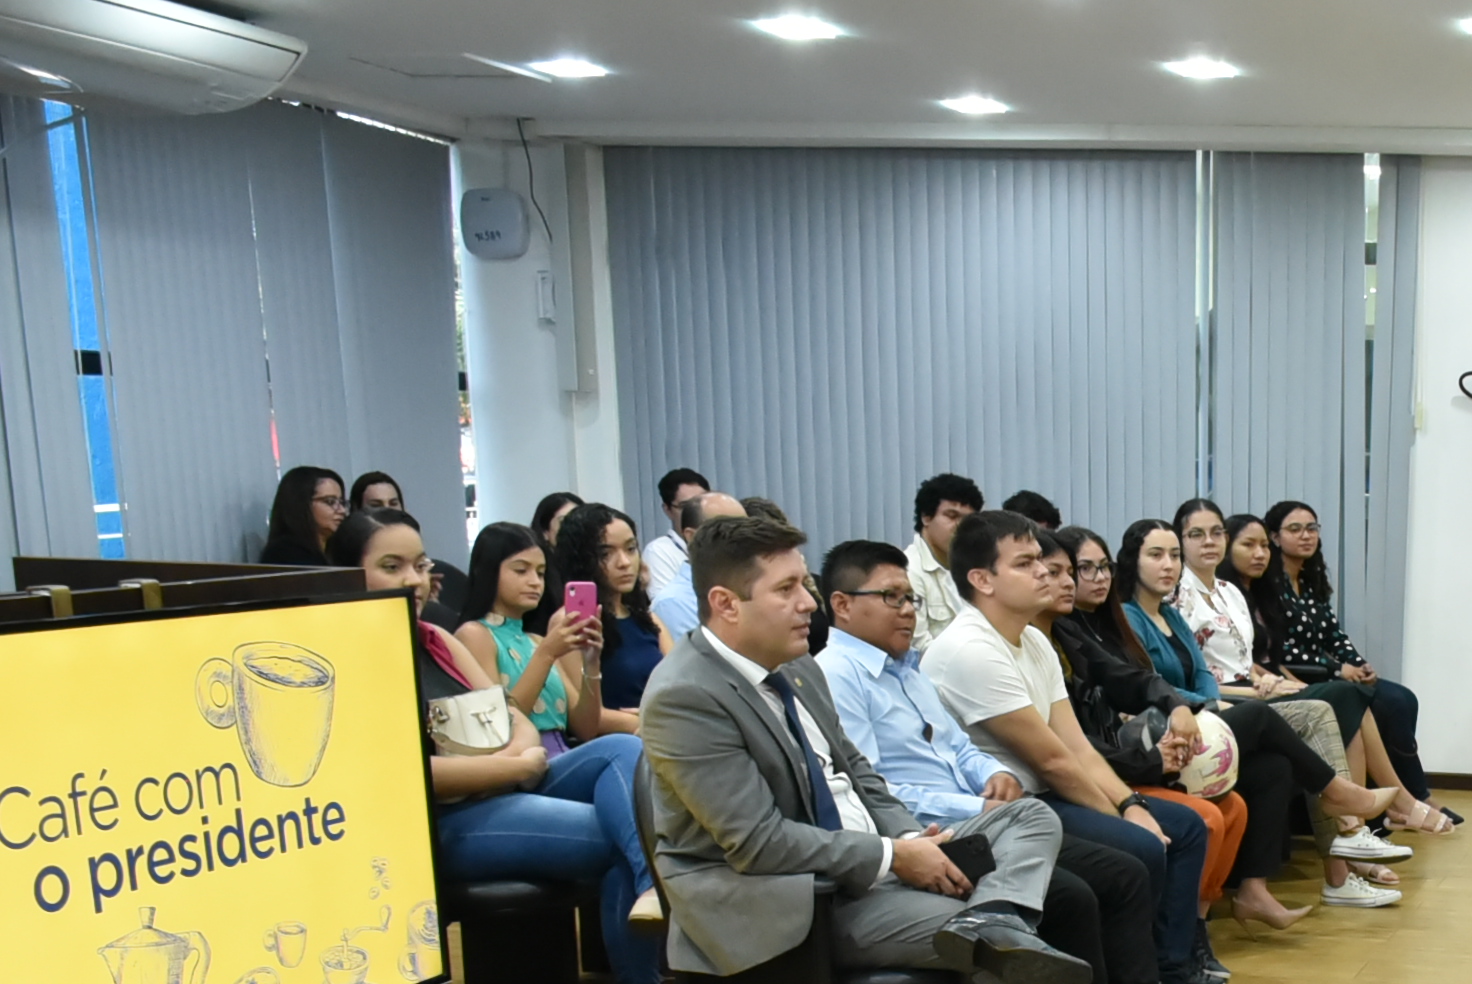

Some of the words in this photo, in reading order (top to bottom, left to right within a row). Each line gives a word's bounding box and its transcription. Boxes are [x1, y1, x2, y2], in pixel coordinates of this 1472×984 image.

[0, 768, 120, 850] Café
[135, 762, 241, 821] com
[34, 865, 71, 913] o
[88, 797, 346, 914] presidente
